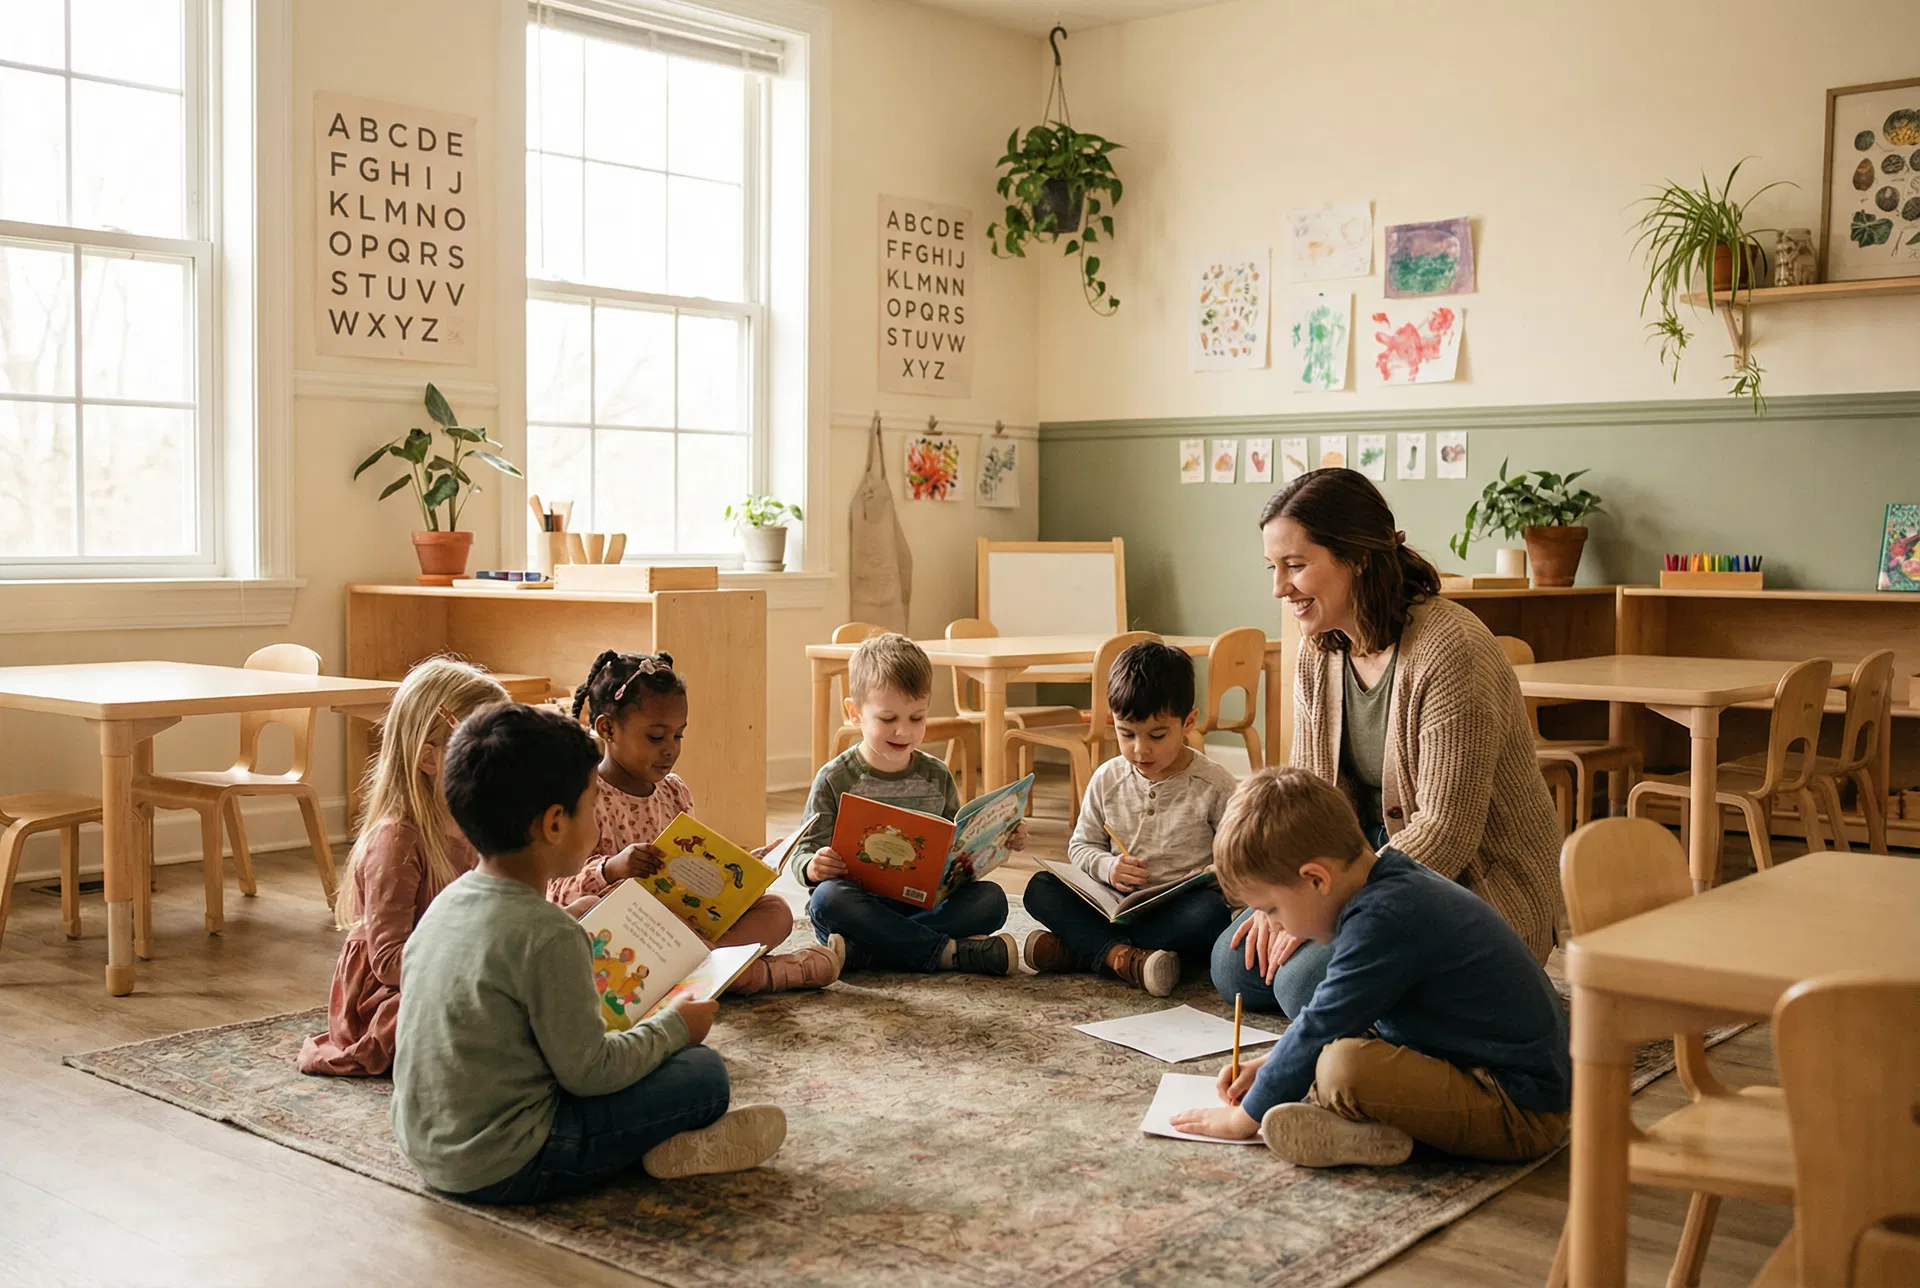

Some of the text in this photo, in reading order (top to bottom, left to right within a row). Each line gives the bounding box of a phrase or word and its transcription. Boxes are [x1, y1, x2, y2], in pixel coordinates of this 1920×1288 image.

[327, 112, 463, 158] ABCDE
[330, 151, 462, 195] FGHIJ
[329, 190, 466, 232] KLMNO
[886, 210, 965, 241] ABCDE
[329, 230, 464, 270] OPQRS
[887, 238, 965, 270] FFGHIJ
[331, 270, 465, 307] STUVV
[887, 268, 965, 297] KLMNN
[328, 308, 439, 343] WXYZ
[886, 297, 965, 325] OPQRS
[887, 326, 966, 354] STUVW
[902, 357, 945, 381] XYZ
